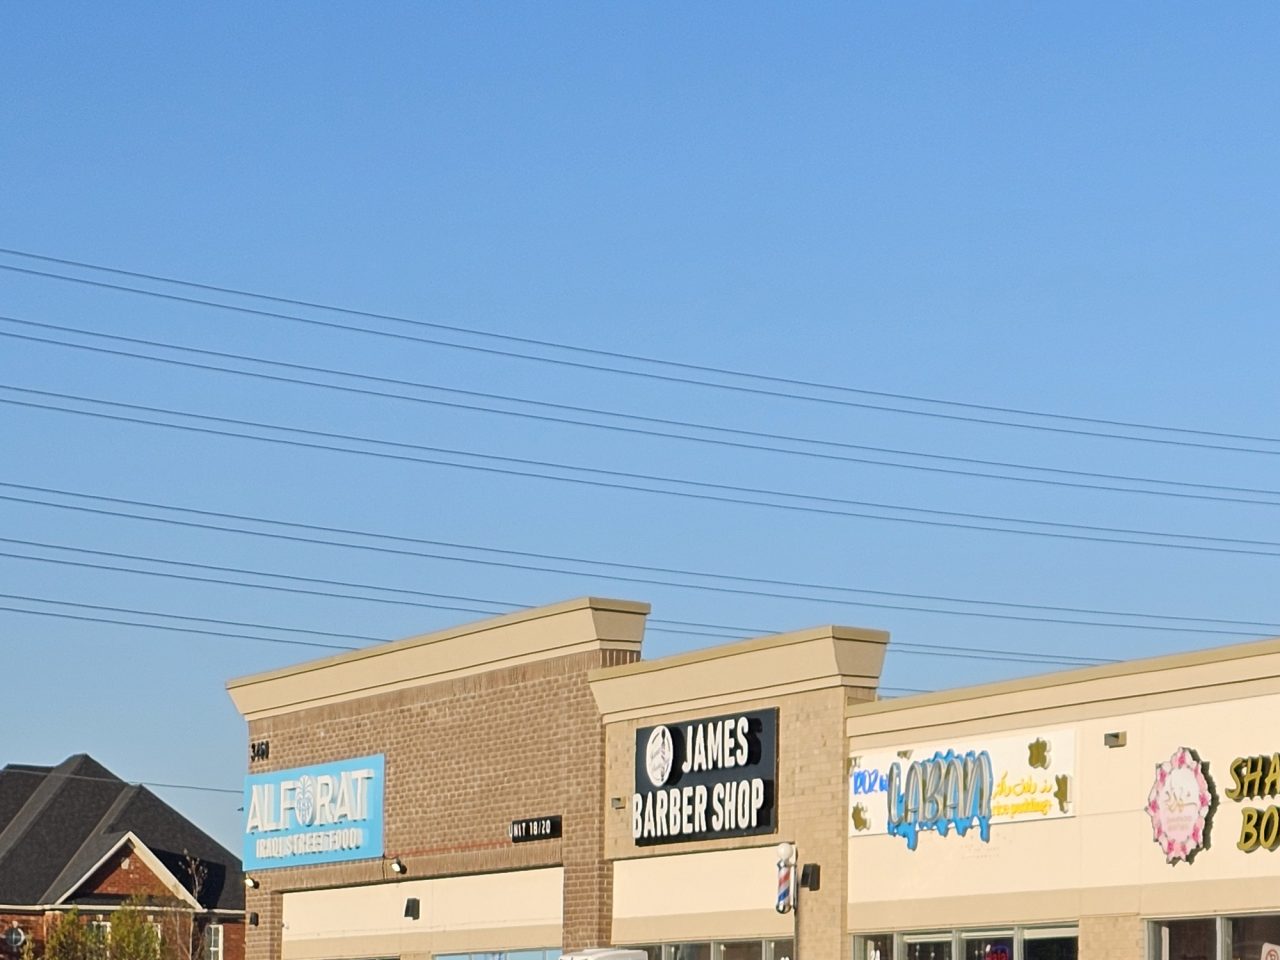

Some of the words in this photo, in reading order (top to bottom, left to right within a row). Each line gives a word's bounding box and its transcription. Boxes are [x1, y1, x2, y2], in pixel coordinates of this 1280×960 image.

[682, 716, 749, 773] JAMES
[632, 785, 707, 839] BARBER
[712, 778, 764, 831] SHOP
[887, 752, 993, 838] LABAN
[508, 822, 526, 838] UNIT
[529, 819, 551, 836] 18/20
